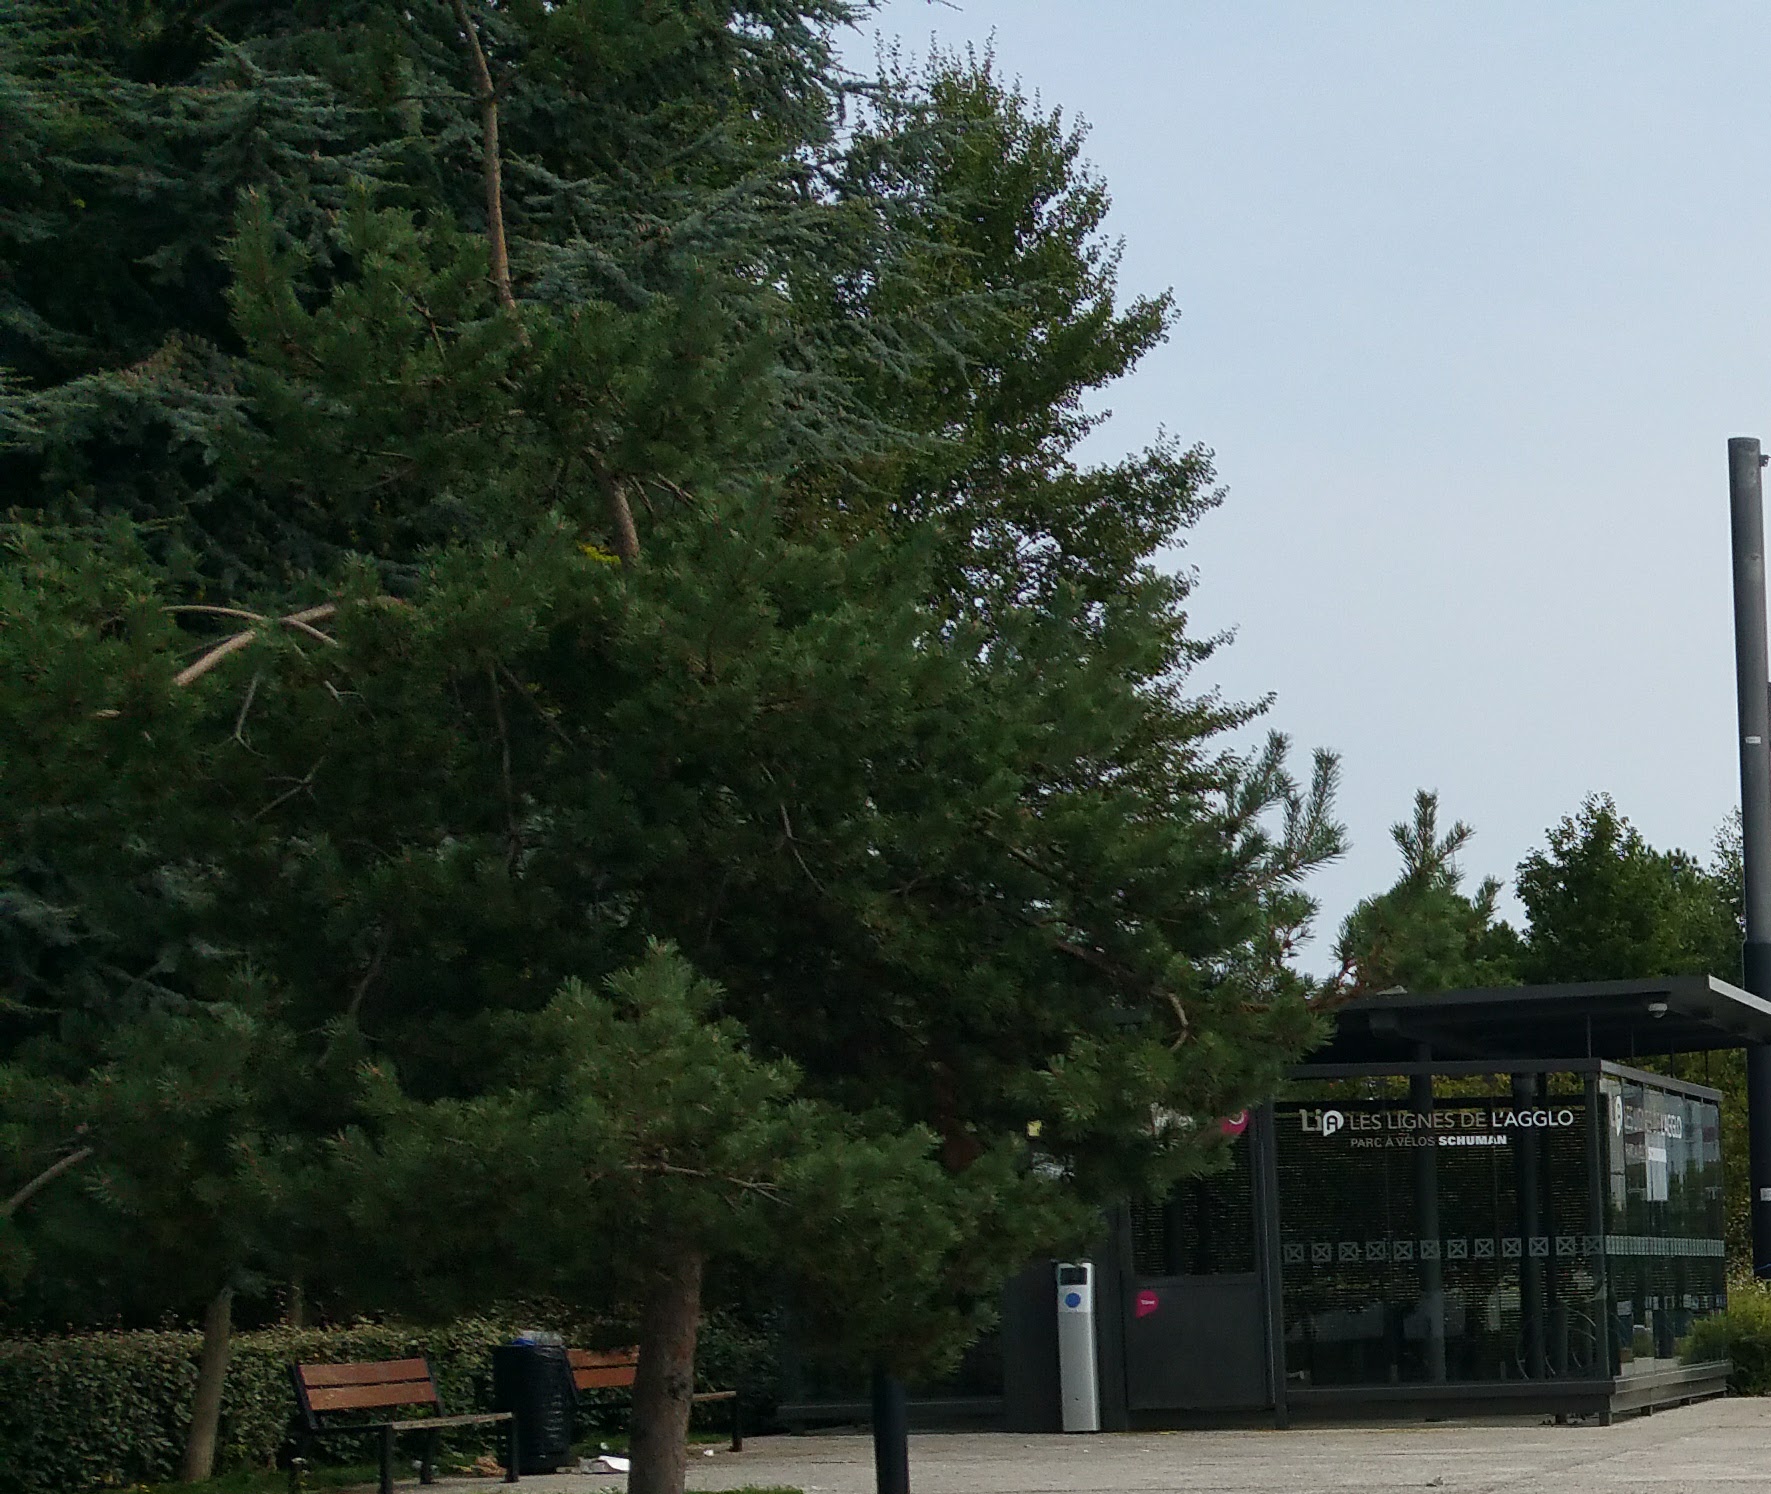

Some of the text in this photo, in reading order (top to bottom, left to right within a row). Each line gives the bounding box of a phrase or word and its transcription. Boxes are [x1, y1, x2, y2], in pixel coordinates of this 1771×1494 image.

[1350, 1113, 1382, 1130] LES
[1388, 1111, 1455, 1129] LIGNES
[1460, 1111, 1487, 1128] DE
[1492, 1109, 1574, 1127] L'AGGLO
[1351, 1137, 1382, 1148] PARC
[1438, 1135, 1507, 1146] SCHUMAN
